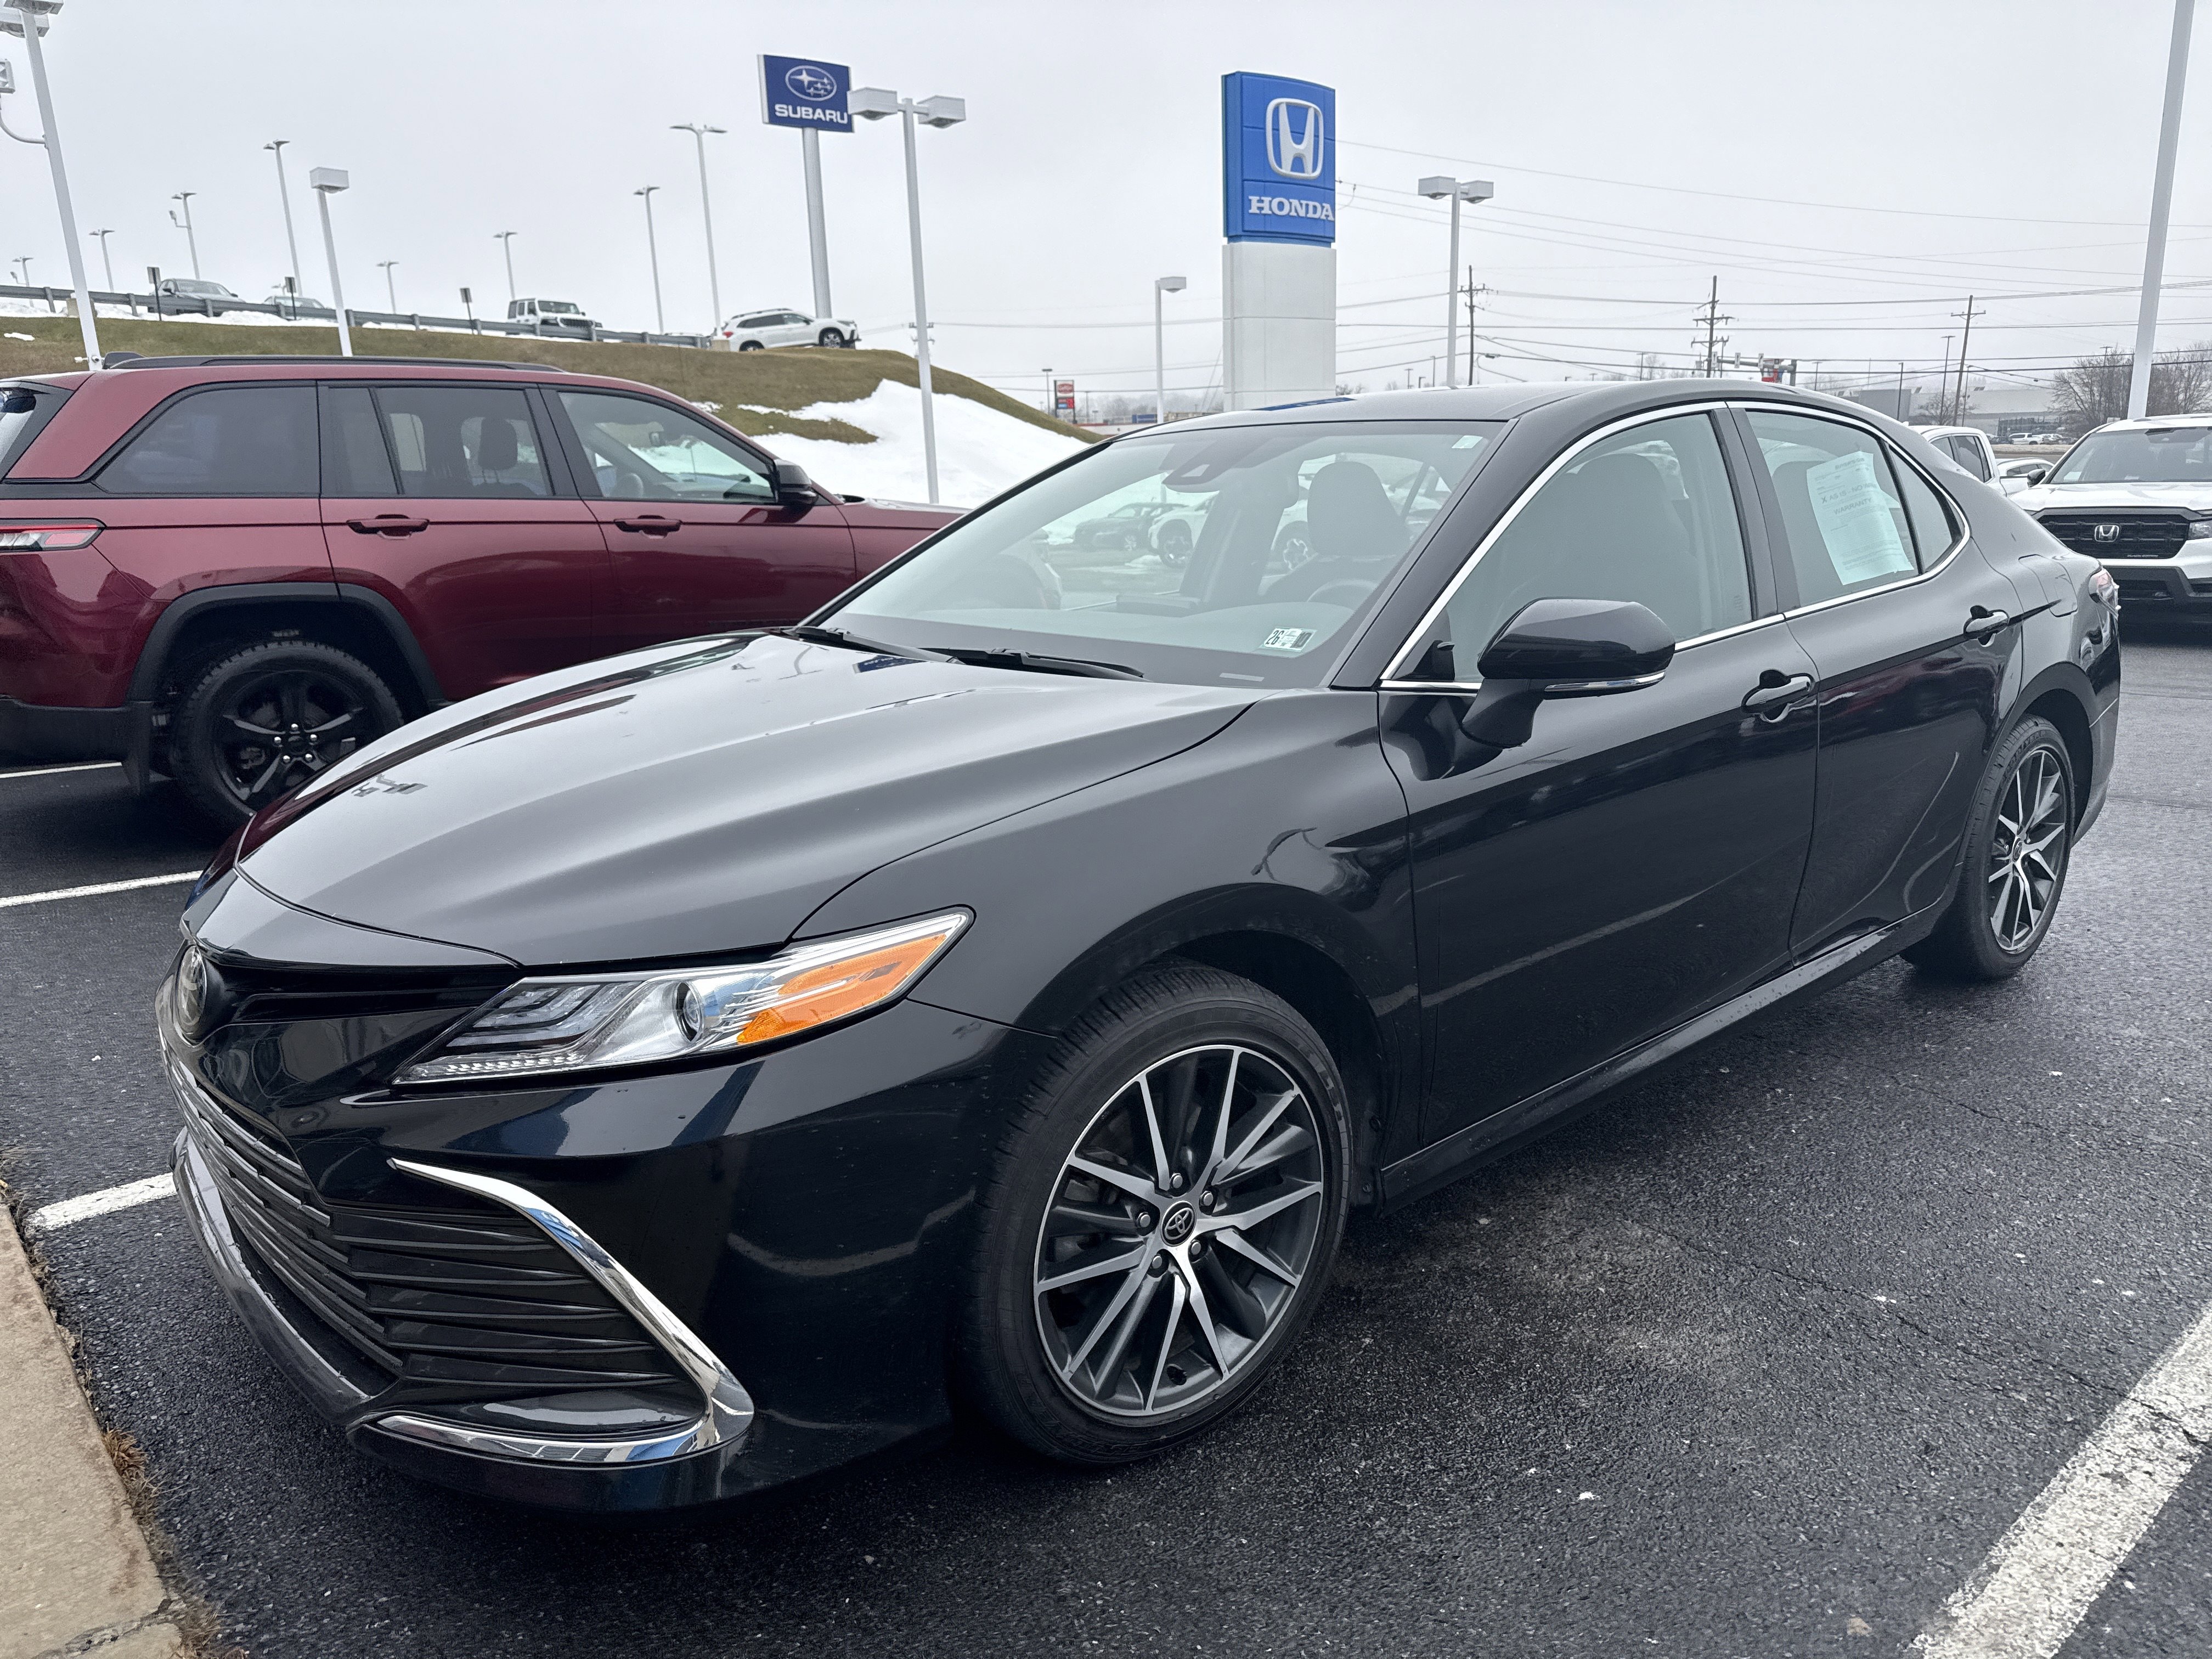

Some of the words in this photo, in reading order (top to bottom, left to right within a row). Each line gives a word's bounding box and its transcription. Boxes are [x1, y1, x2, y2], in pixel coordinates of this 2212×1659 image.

[774, 104, 848, 125] SUBARU
[1248, 196, 1335, 221] HONDA
[1266, 630, 1285, 645] 26
